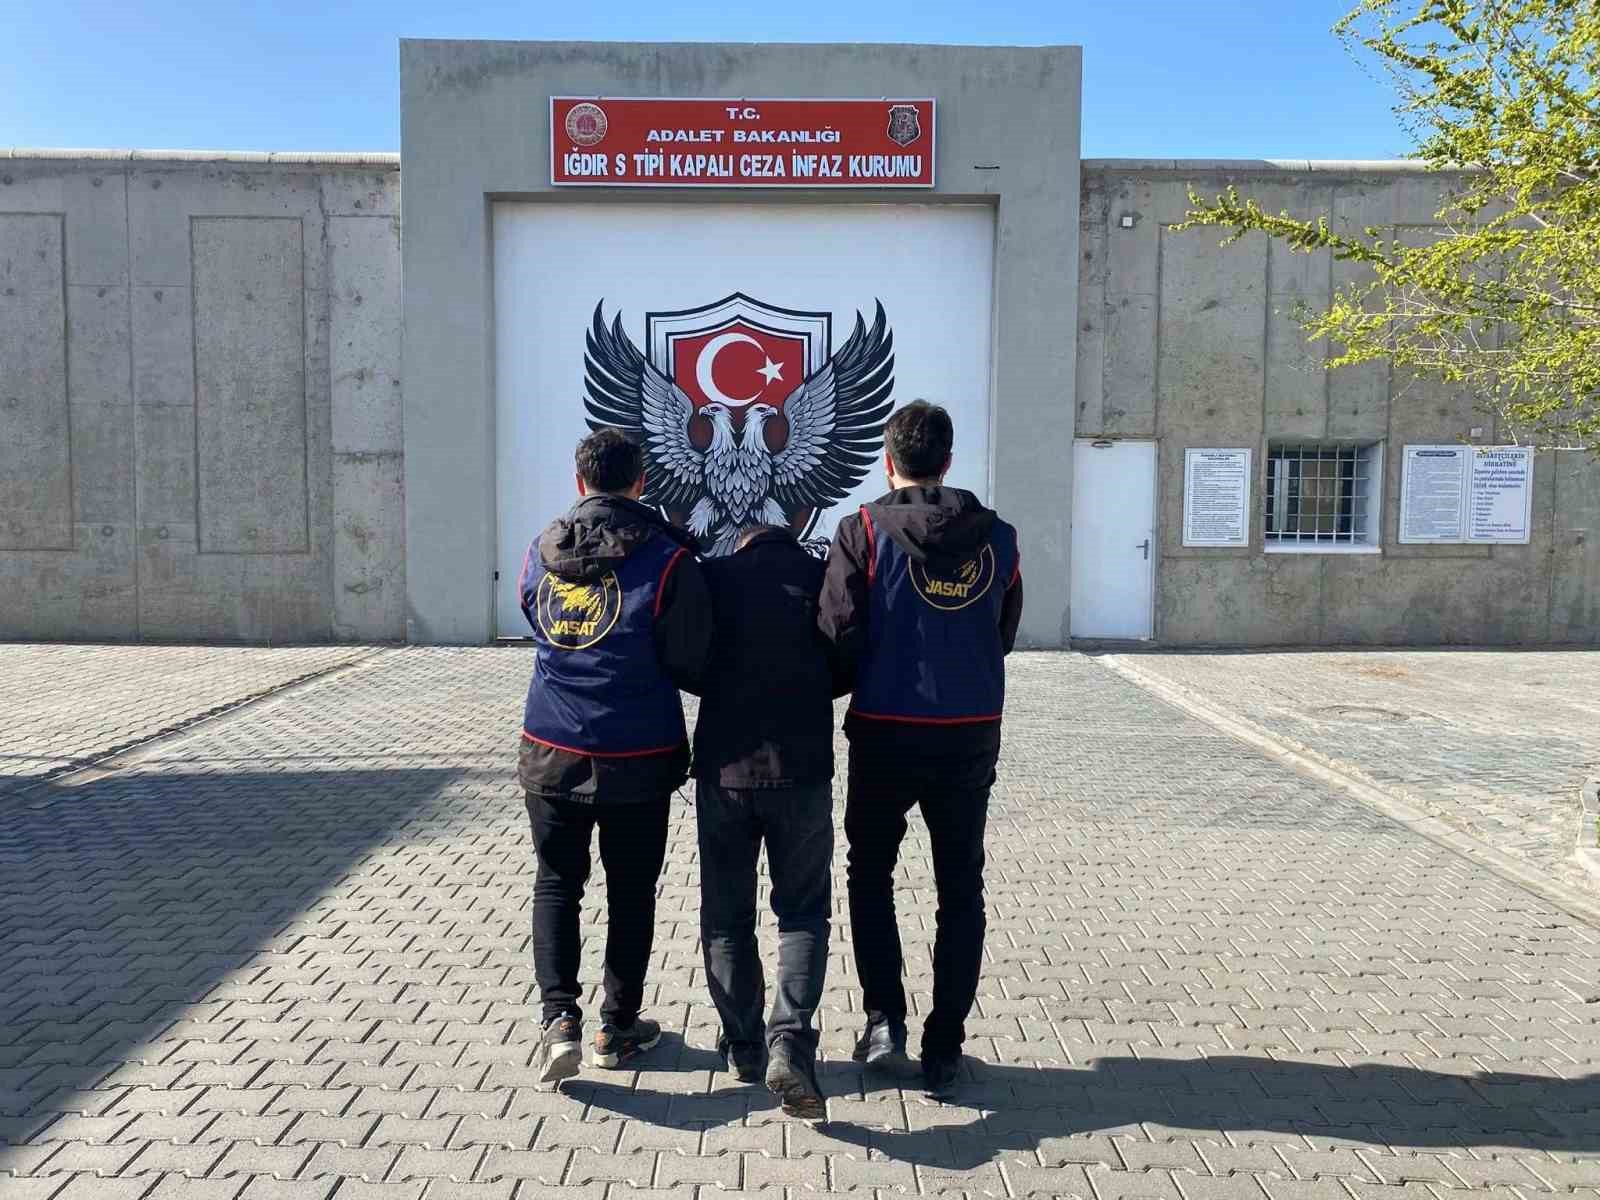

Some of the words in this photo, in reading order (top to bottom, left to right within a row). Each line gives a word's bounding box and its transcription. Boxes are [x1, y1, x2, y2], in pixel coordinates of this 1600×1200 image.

[726, 107, 760, 120] T.C.
[646, 129, 724, 142] ADALET
[734, 125, 841, 143] BAKANLIĞI
[564, 146, 608, 176] IĞDIR
[615, 154, 626, 176] S
[633, 147, 664, 176] TİPİ
[670, 154, 732, 177] KAPALI
[739, 154, 786, 177] CEZA
[792, 148, 842, 177] İNFAZ
[848, 154, 922, 177] KURUMU
[925, 579, 970, 598] JASAT
[550, 620, 598, 636] JASAT
